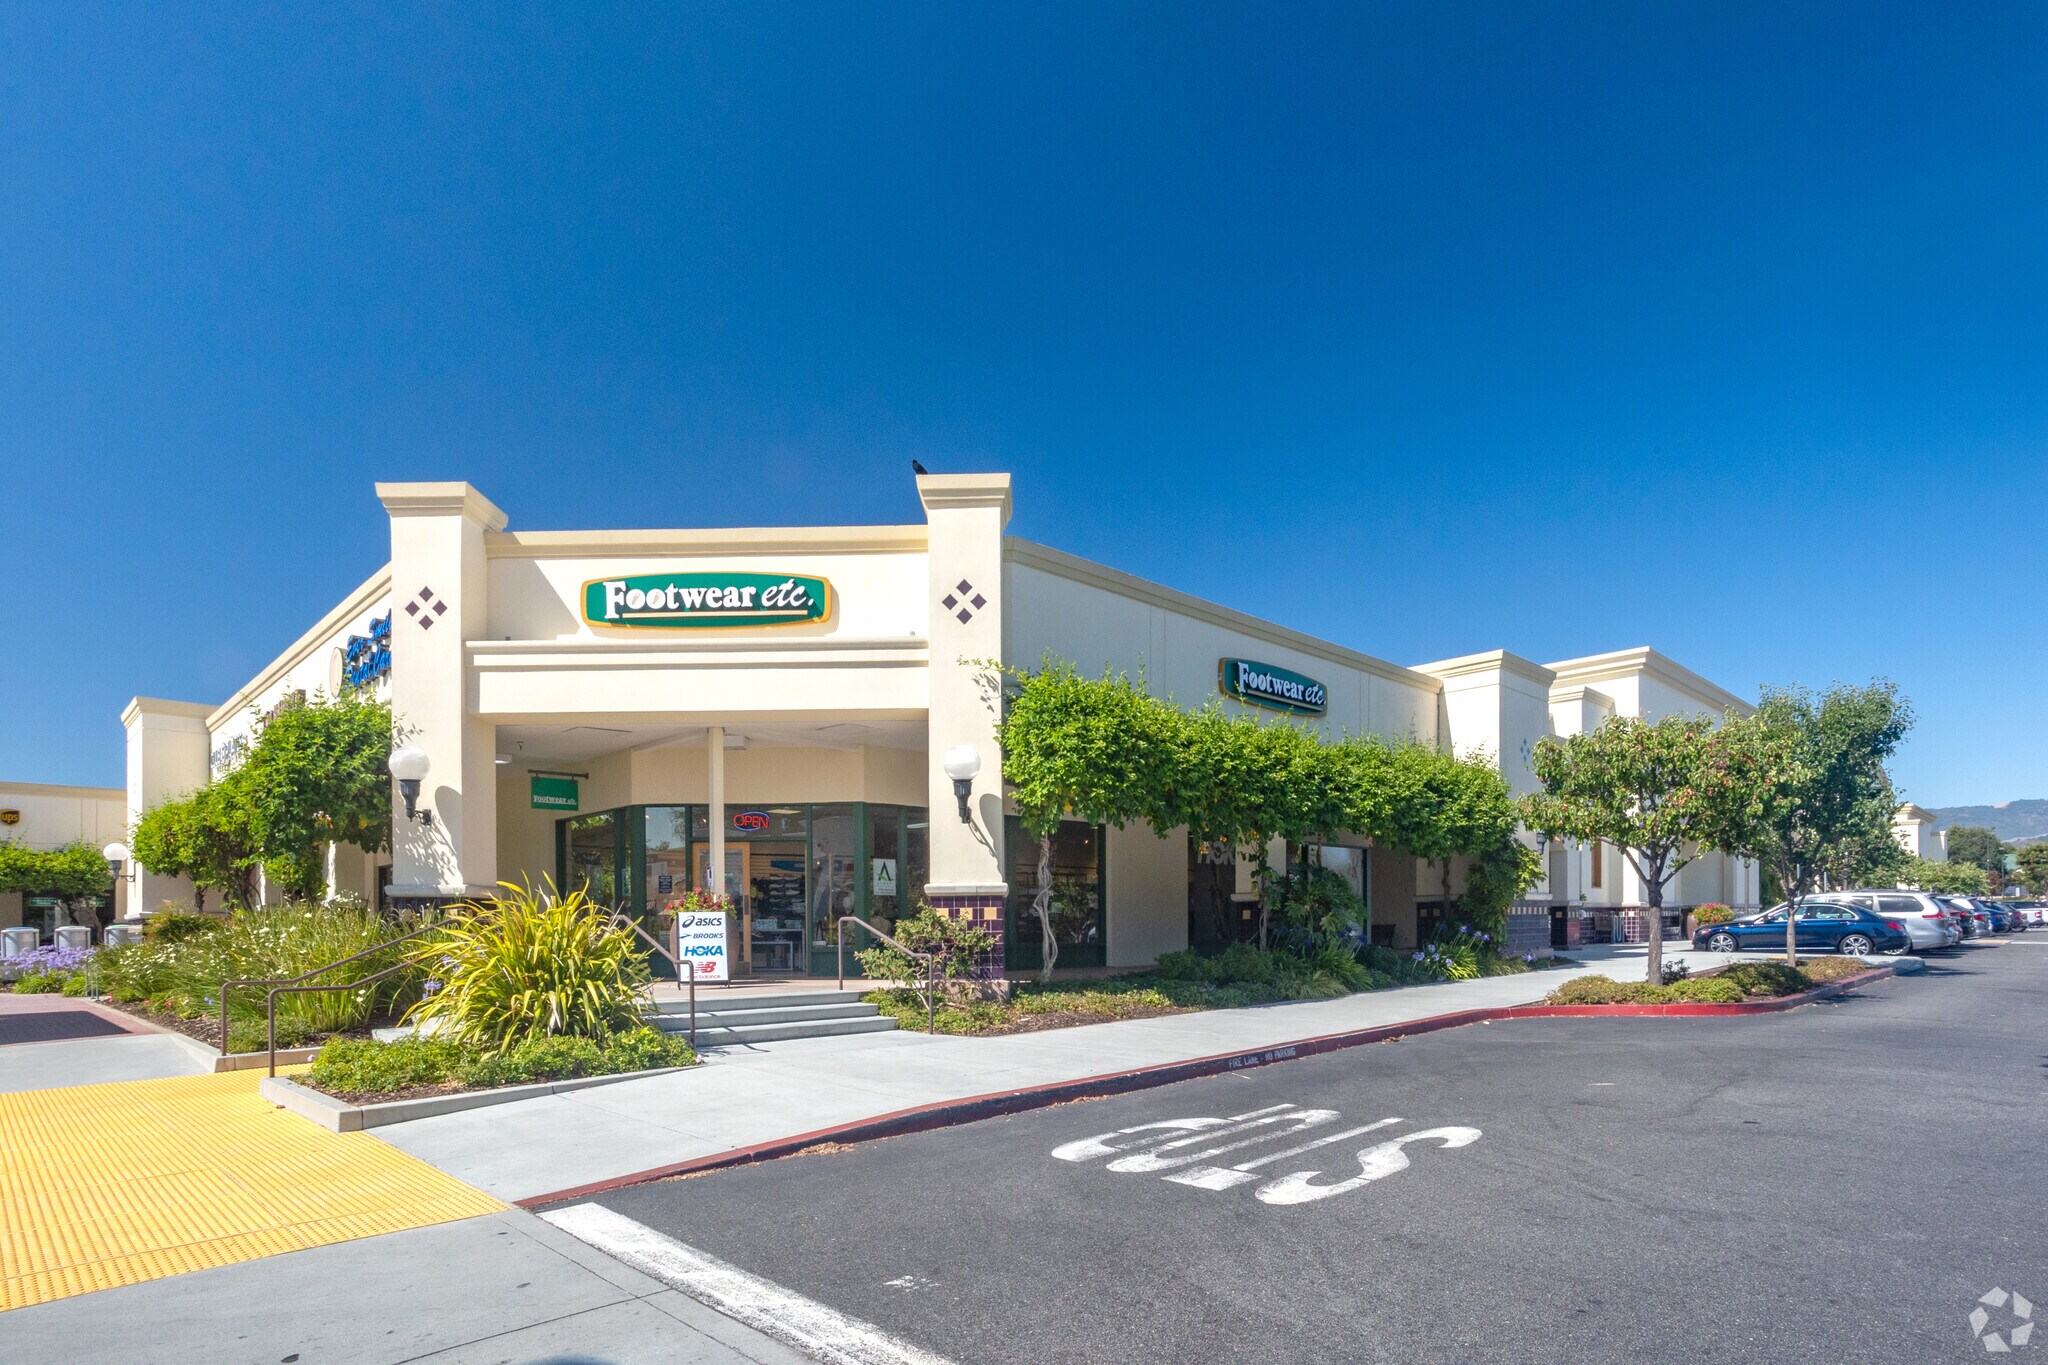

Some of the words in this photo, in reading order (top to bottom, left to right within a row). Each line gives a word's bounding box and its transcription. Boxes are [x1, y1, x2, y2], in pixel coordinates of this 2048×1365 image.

[603, 581, 756, 619] Footwear
[761, 579, 814, 607] etc.
[1238, 662, 1304, 700] Footwear
[1305, 683, 1326, 705] etc.
[533, 795, 566, 804] Footwear
[2, 814, 18, 823] ups
[733, 814, 769, 829] OPEN
[695, 917, 722, 926] asics
[684, 945, 723, 956] HOKA
[1229, 1057, 1242, 1068] FIRE
[1265, 1053, 1272, 1061] NO
[1274, 1047, 1295, 1058] PARKING
[1051, 1103, 1482, 1205] STOP
